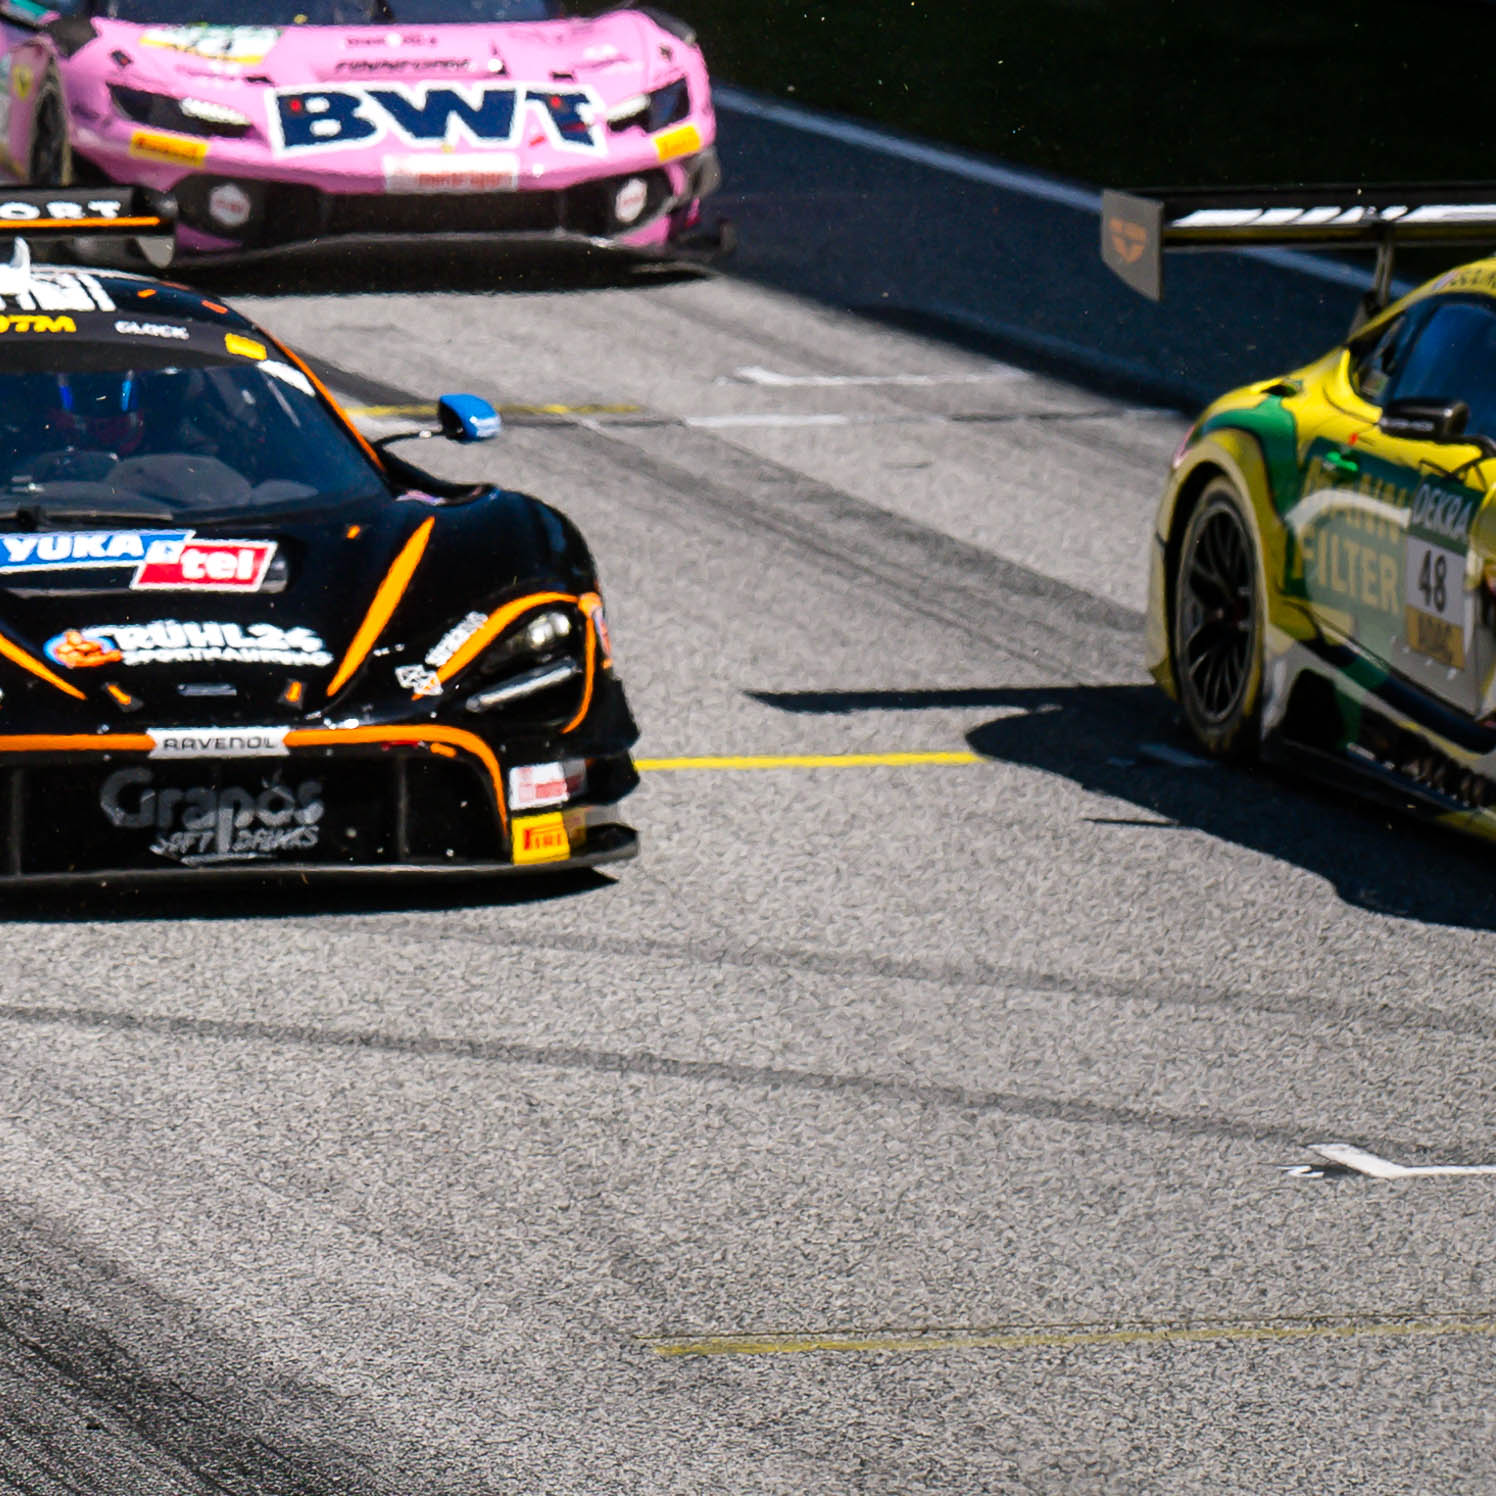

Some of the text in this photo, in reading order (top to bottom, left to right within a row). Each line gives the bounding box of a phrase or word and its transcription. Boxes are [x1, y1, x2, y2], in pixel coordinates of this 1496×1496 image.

[272, 86, 605, 152] BWT
[1411, 483, 1473, 542] DEKRA
[2, 534, 145, 562] YUKA
[181, 549, 255, 580] tel
[1292, 524, 1401, 615] FILTER
[1418, 549, 1447, 613] 48
[162, 736, 277, 751] RAVENOL
